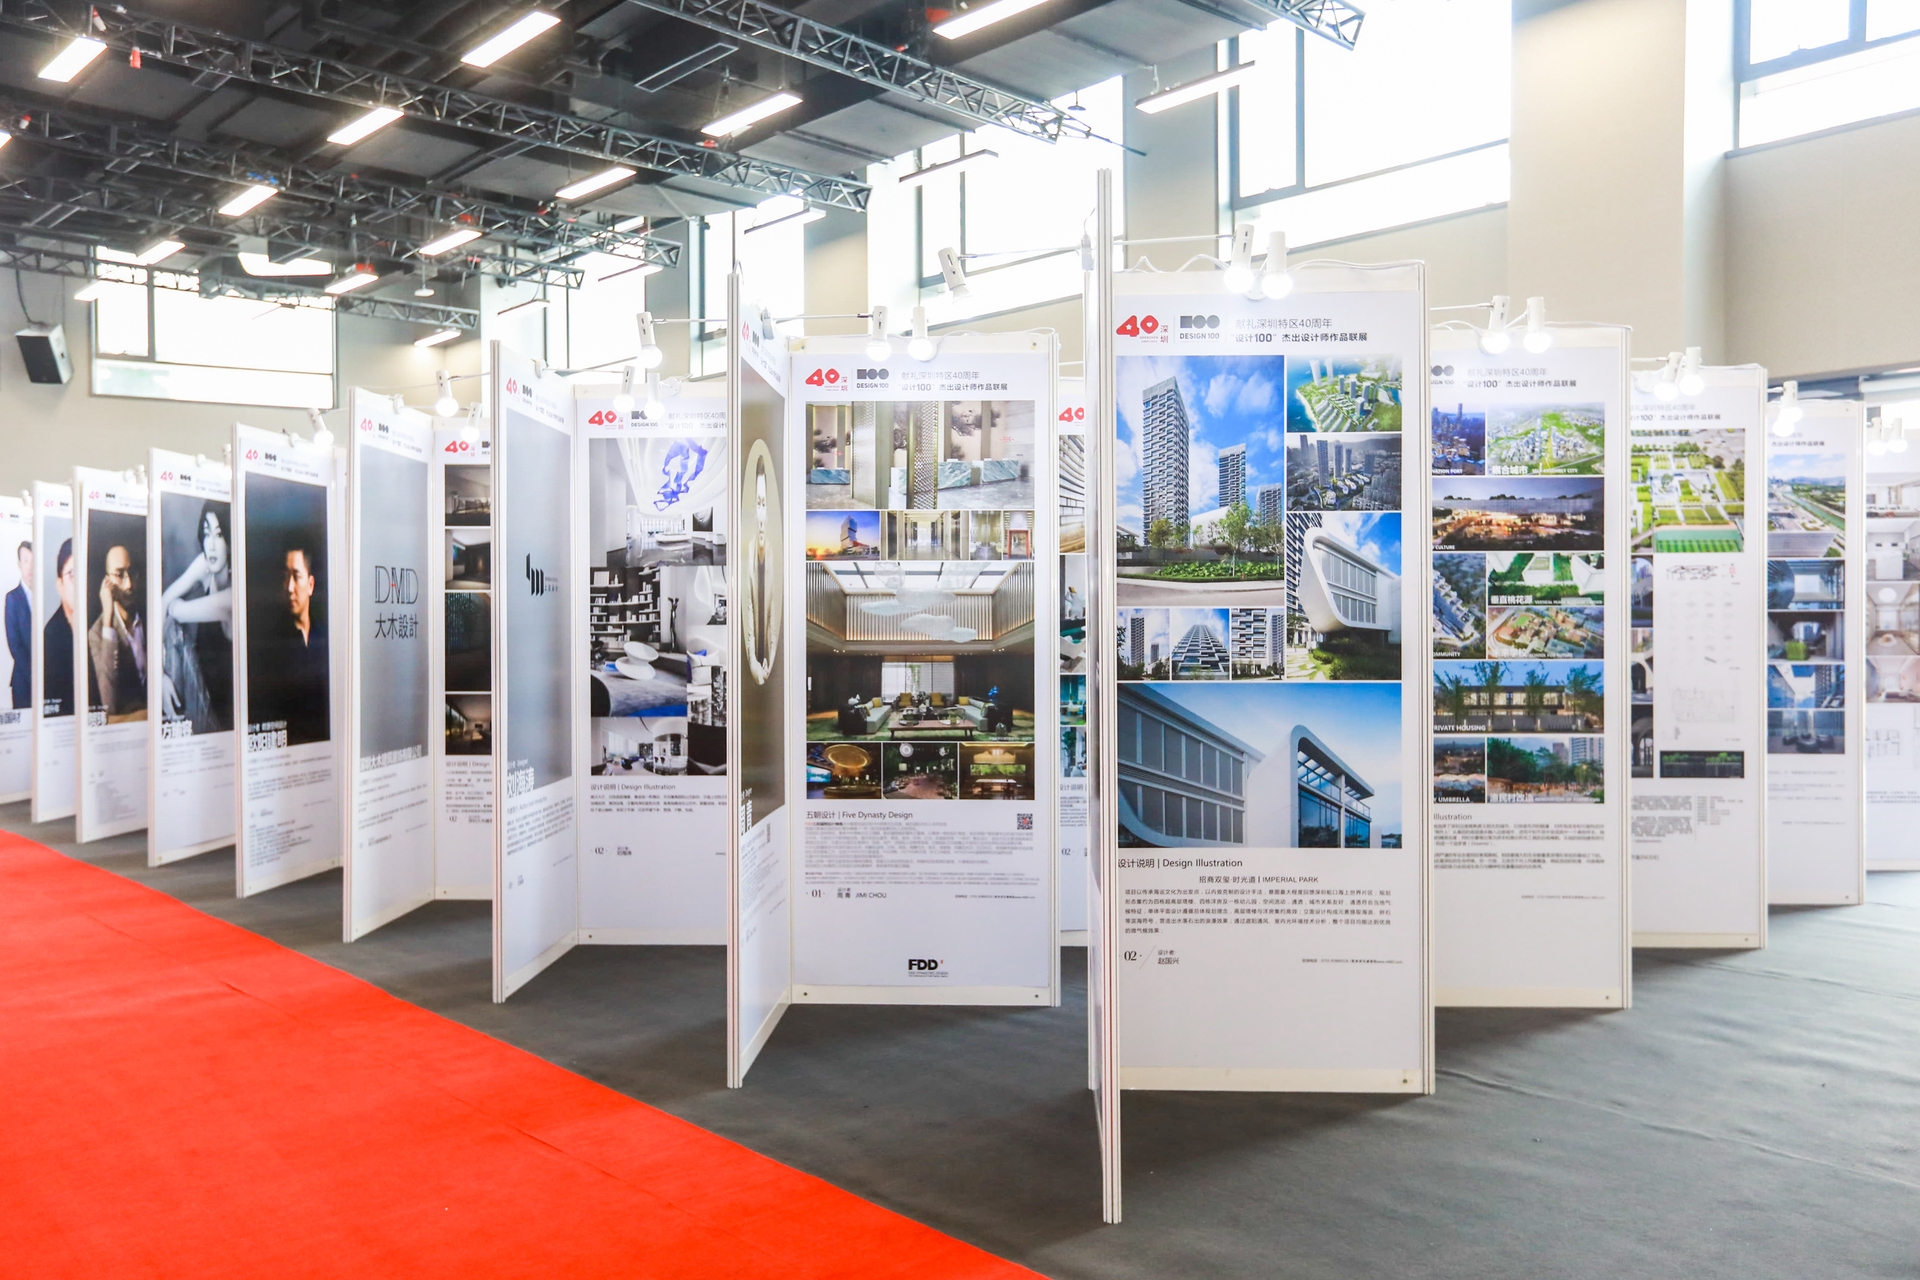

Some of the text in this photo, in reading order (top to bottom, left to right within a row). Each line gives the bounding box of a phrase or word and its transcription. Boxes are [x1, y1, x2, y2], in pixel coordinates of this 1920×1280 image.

[1236, 318, 1333, 329] 献礼深圳特区40周年
[1282, 332, 1368, 342] 杰出设计师作品联展
[939, 383, 1008, 391] 杰出设计师作品联展
[1506, 380, 1577, 388] 杰出设计师作品联展
[375, 565, 419, 605] DMD
[375, 612, 419, 640] 大木設計
[621, 783, 642, 791] Design
[842, 811, 856, 819] Five
[858, 811, 887, 820] Dynasty
[888, 811, 914, 820] Design
[1117, 858, 1243, 869] 设计说明 Design Illustration
[1262, 876, 1297, 884] IMPERIAL
[1298, 876, 1319, 884] PARK
[1124, 950, 1137, 961] 02
[908, 959, 939, 970] FDD
